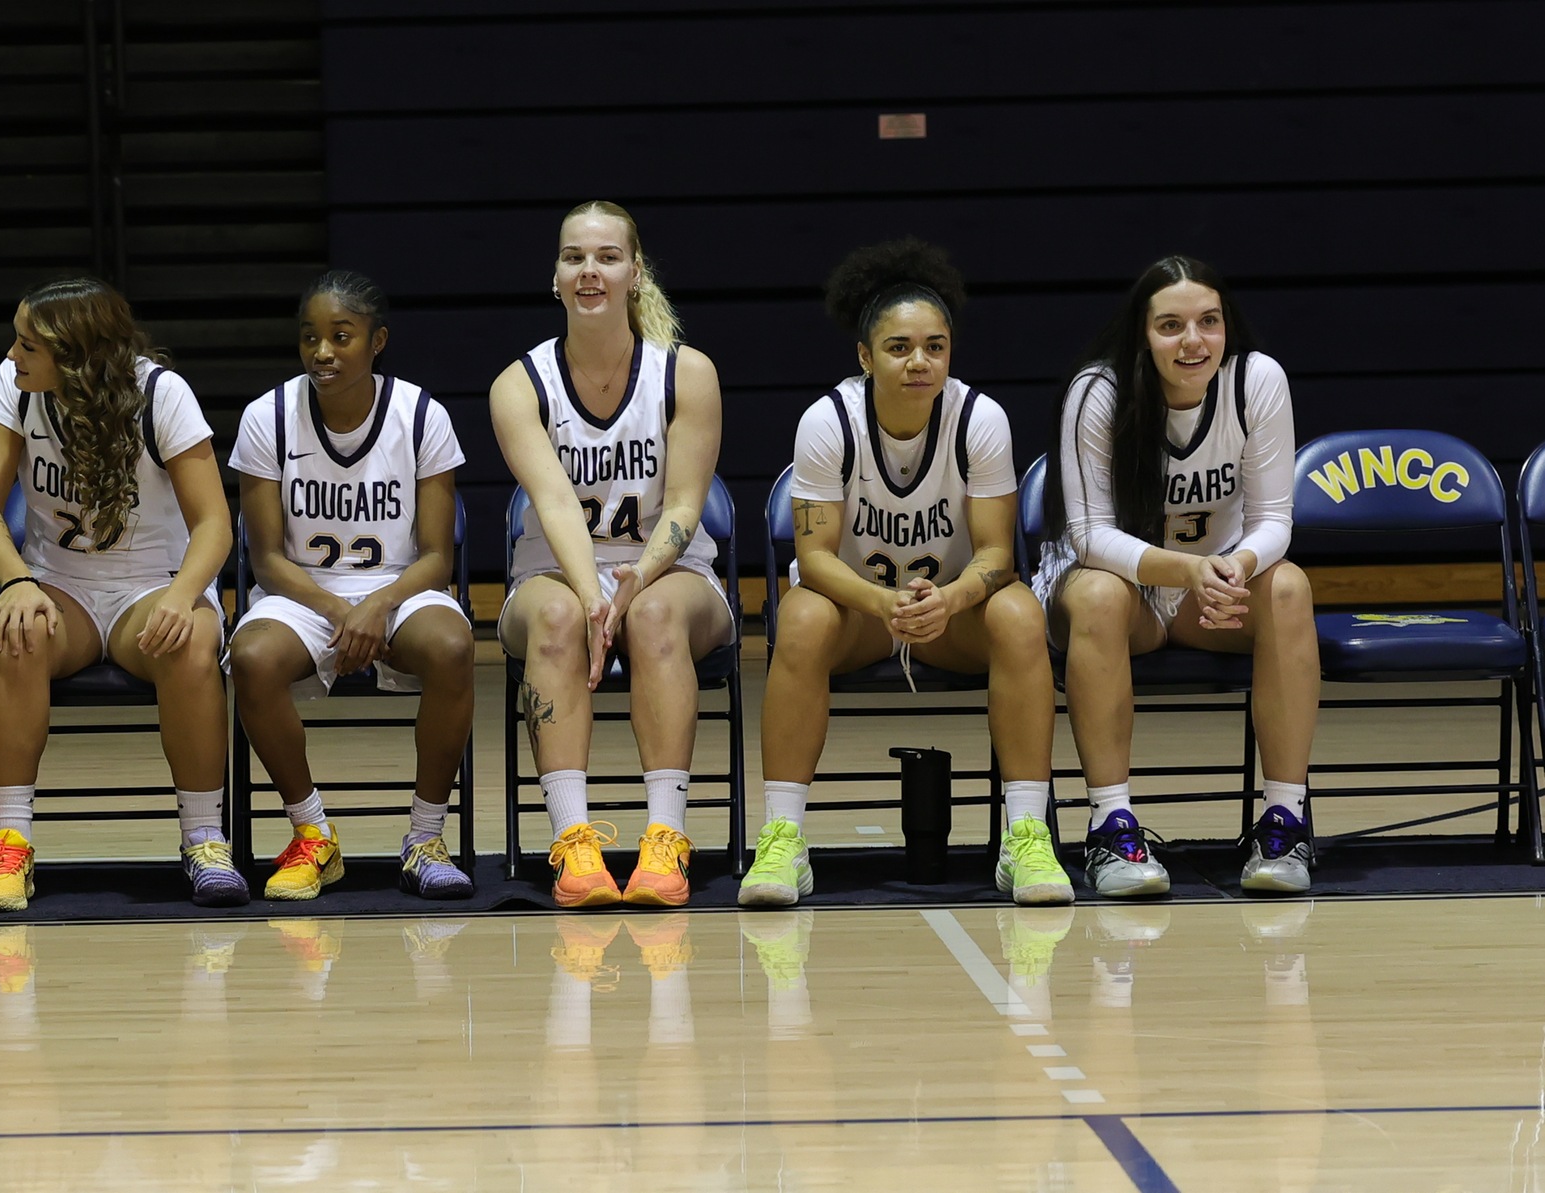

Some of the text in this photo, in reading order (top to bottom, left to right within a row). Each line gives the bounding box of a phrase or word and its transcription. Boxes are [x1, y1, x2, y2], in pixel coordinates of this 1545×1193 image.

[559, 438, 658, 486] COUGARS
[1164, 463, 1235, 505] GARS
[1308, 446, 1470, 503] WNCC
[291, 478, 401, 521] COUGARS
[852, 497, 954, 547] COUGARS
